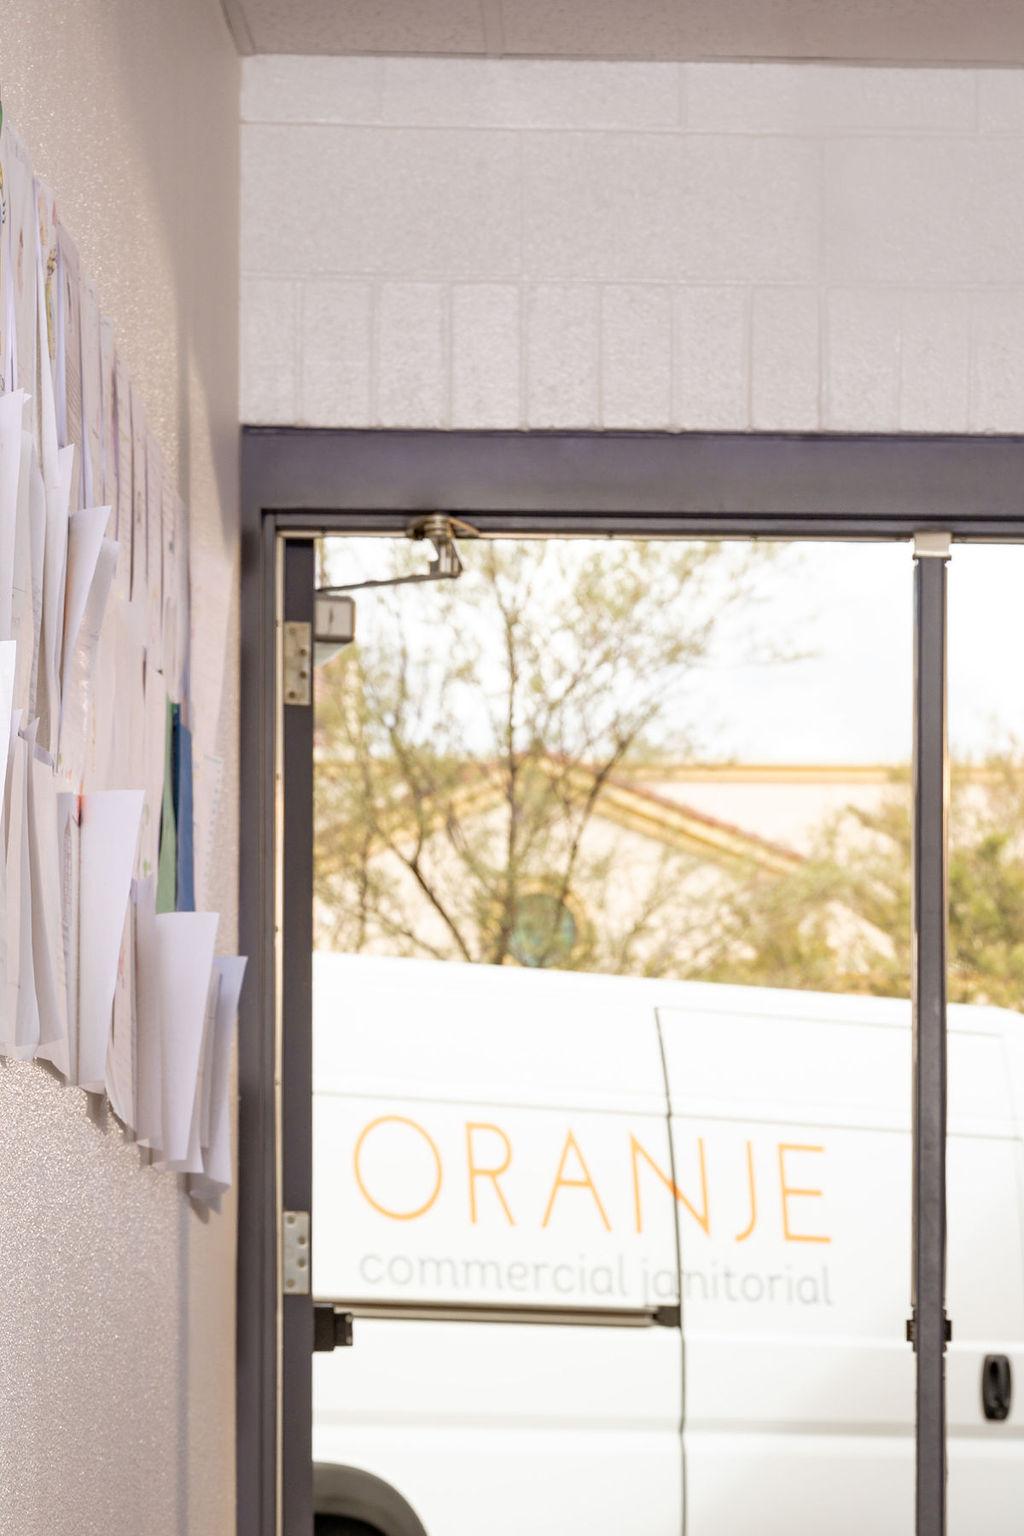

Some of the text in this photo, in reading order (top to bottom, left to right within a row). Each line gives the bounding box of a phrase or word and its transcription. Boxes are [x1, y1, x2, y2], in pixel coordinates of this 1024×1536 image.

[354, 1115, 831, 1243] ORANJE
[359, 1252, 627, 1297] commercial
[643, 1258, 836, 1307] janitorial
